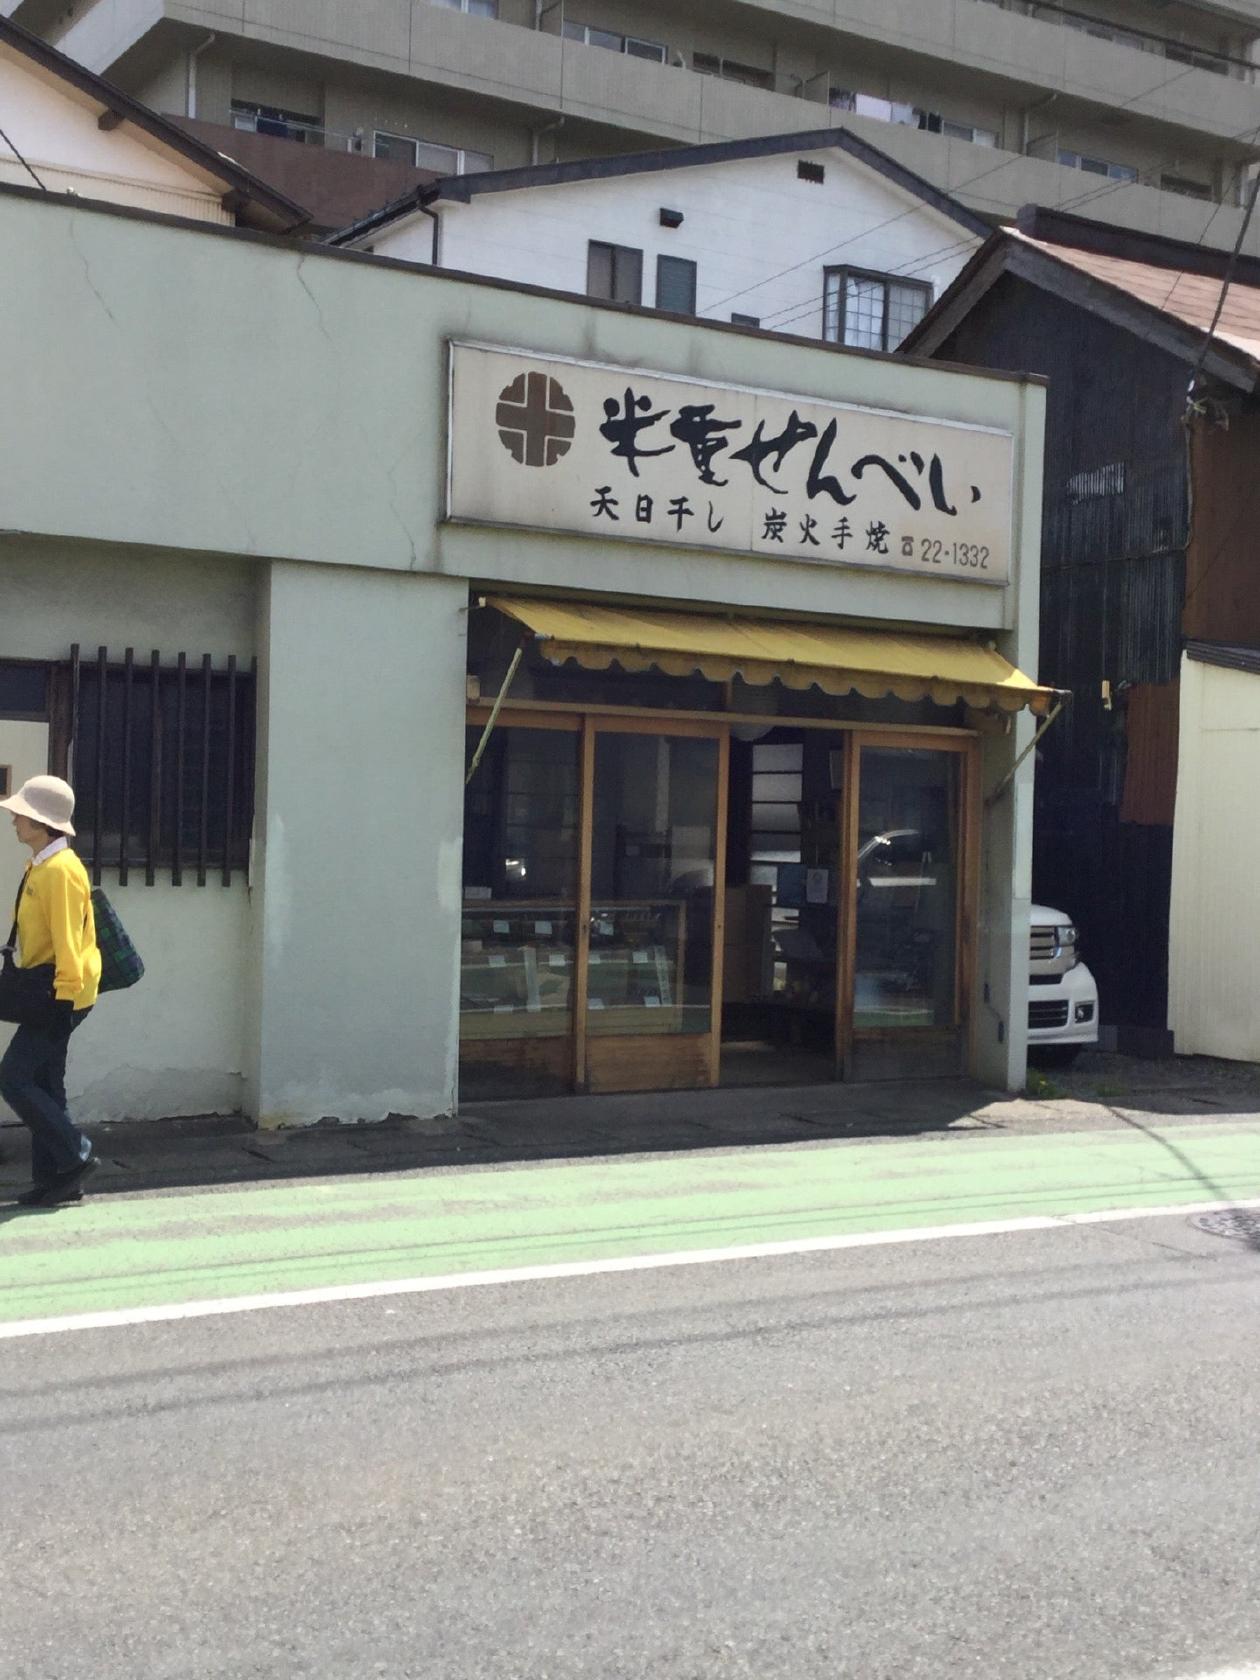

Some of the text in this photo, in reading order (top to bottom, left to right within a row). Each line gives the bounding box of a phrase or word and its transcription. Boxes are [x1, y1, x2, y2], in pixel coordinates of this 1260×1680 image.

[589, 486, 890, 554] 天日干し 炭火手焼
